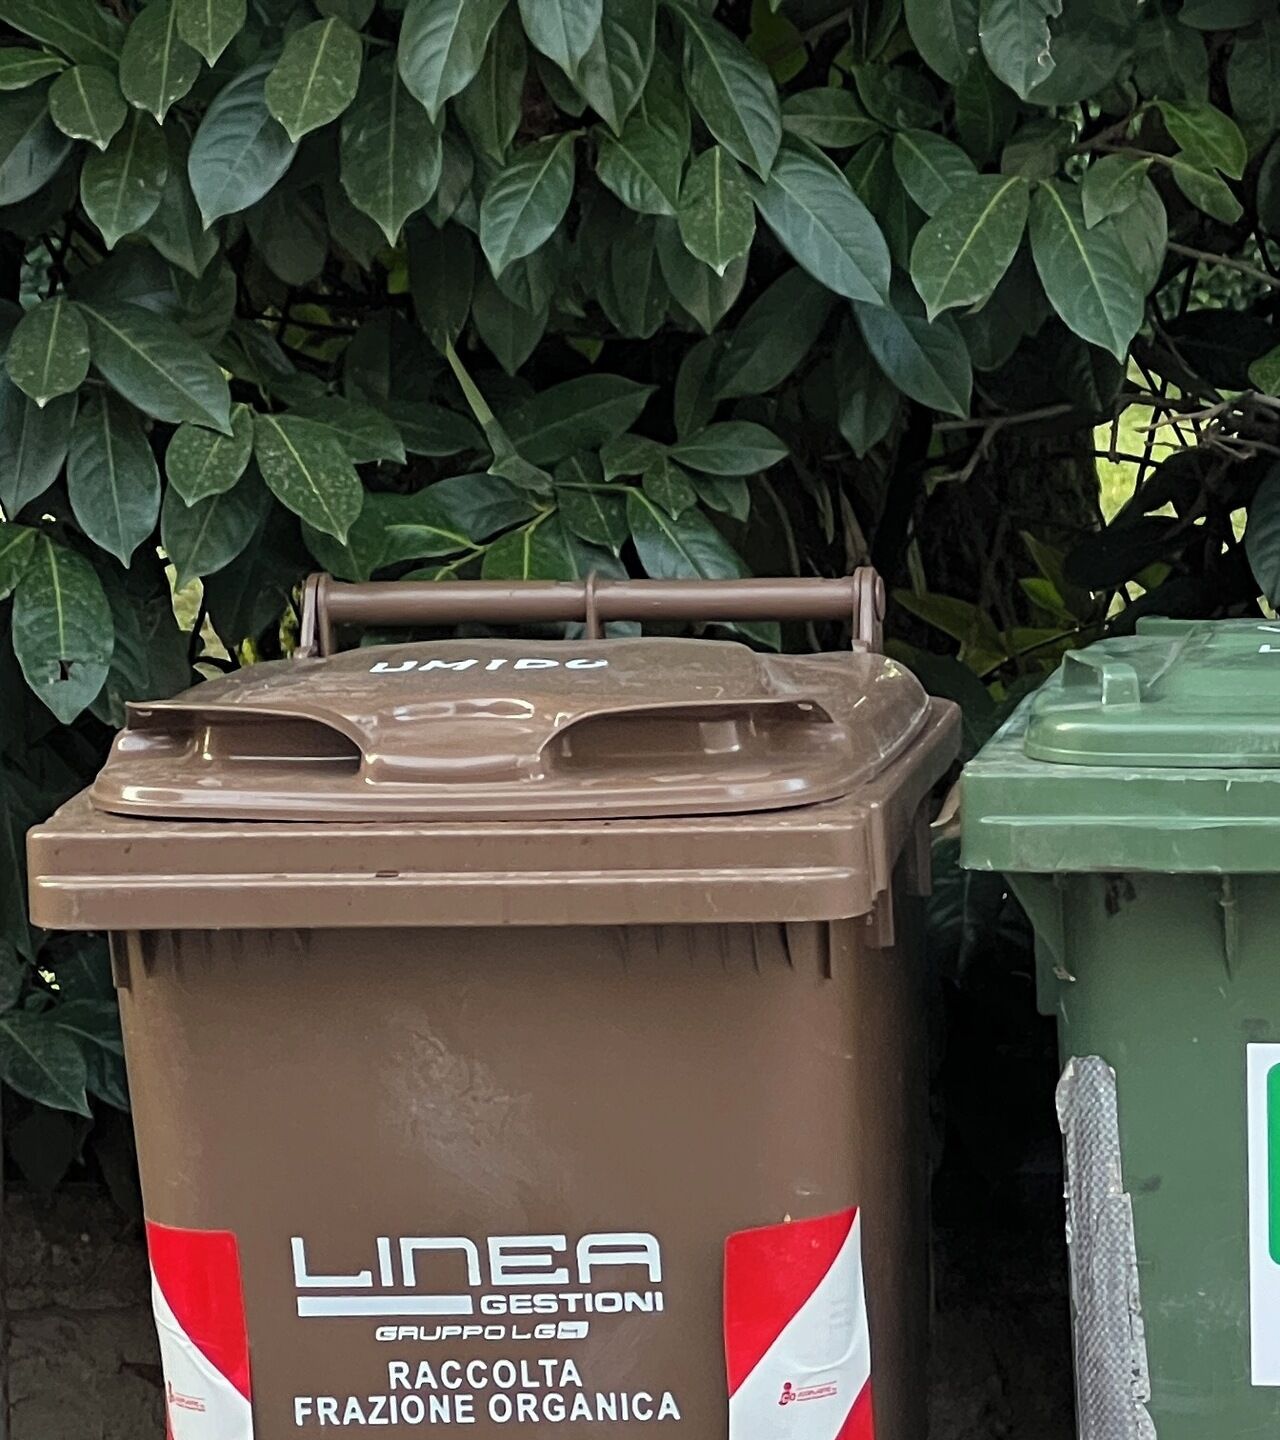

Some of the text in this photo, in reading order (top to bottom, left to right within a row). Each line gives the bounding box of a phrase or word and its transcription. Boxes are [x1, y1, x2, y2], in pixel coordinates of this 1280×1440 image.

[369, 658, 608, 673] UMIDO
[290, 1232, 663, 1287] LINEA
[480, 1291, 664, 1314] GESTIONI
[375, 1325, 505, 1341] GRUPPO
[388, 1359, 583, 1390] RACCOLTA
[294, 1391, 681, 1426] FRAZIONE ORGANICA
